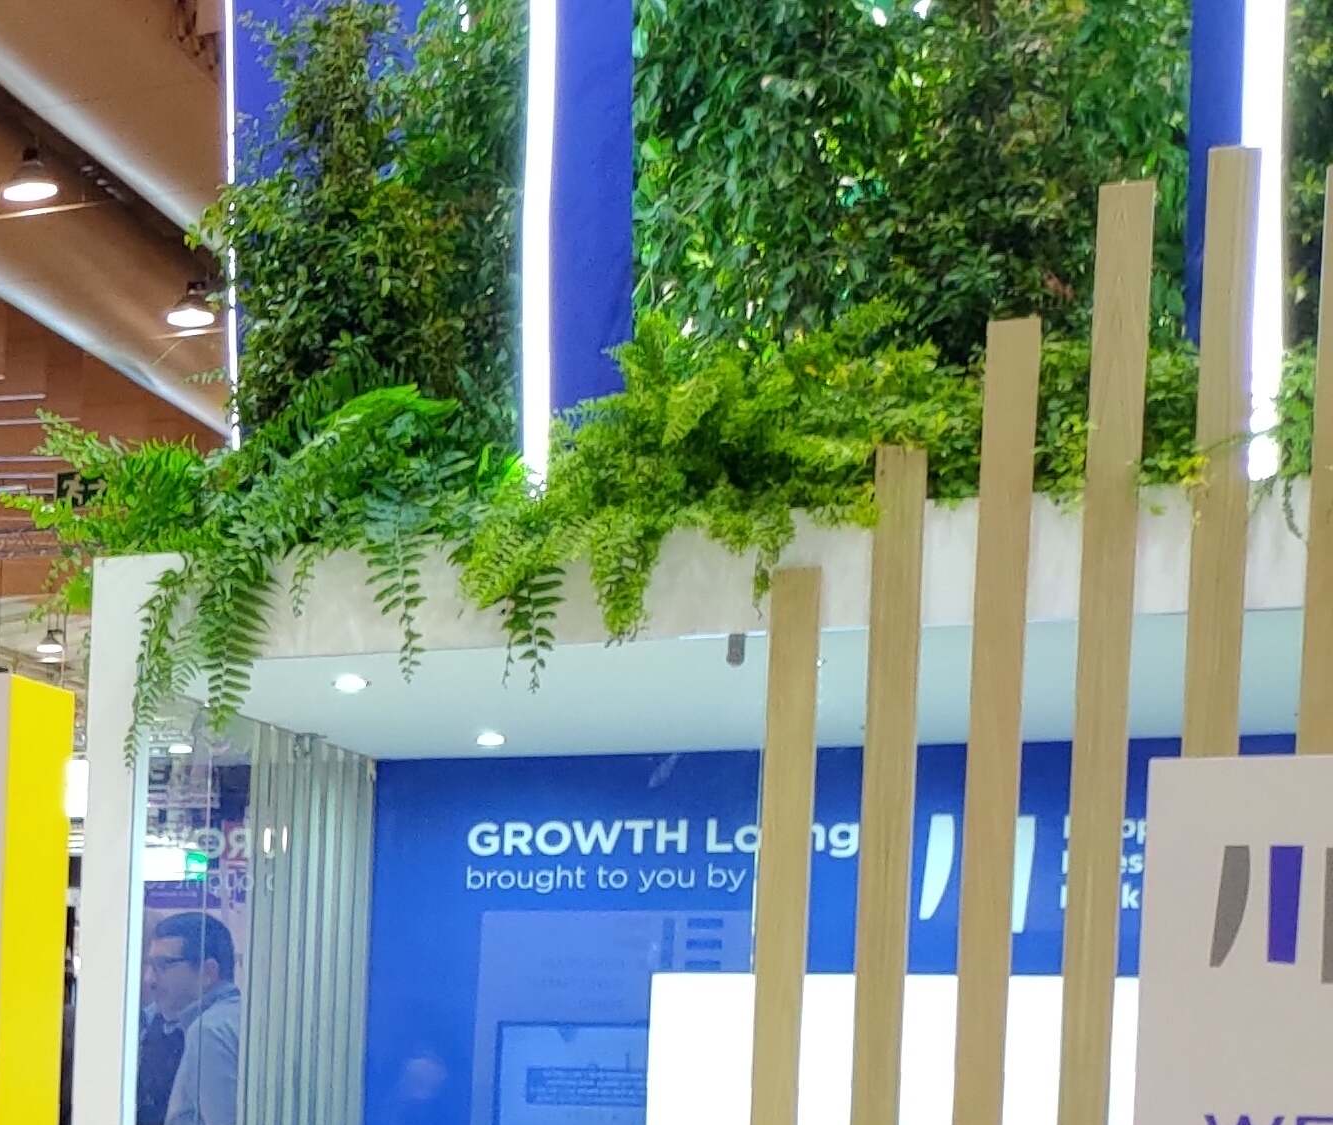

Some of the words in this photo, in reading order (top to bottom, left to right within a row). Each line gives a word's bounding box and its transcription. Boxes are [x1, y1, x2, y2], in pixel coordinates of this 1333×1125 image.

[467, 818, 688, 857] GROWTH
[706, 818, 861, 858] Long
[465, 865, 586, 895] brought
[596, 867, 628, 889] to
[637, 868, 696, 894] you
[707, 863, 747, 893] by
